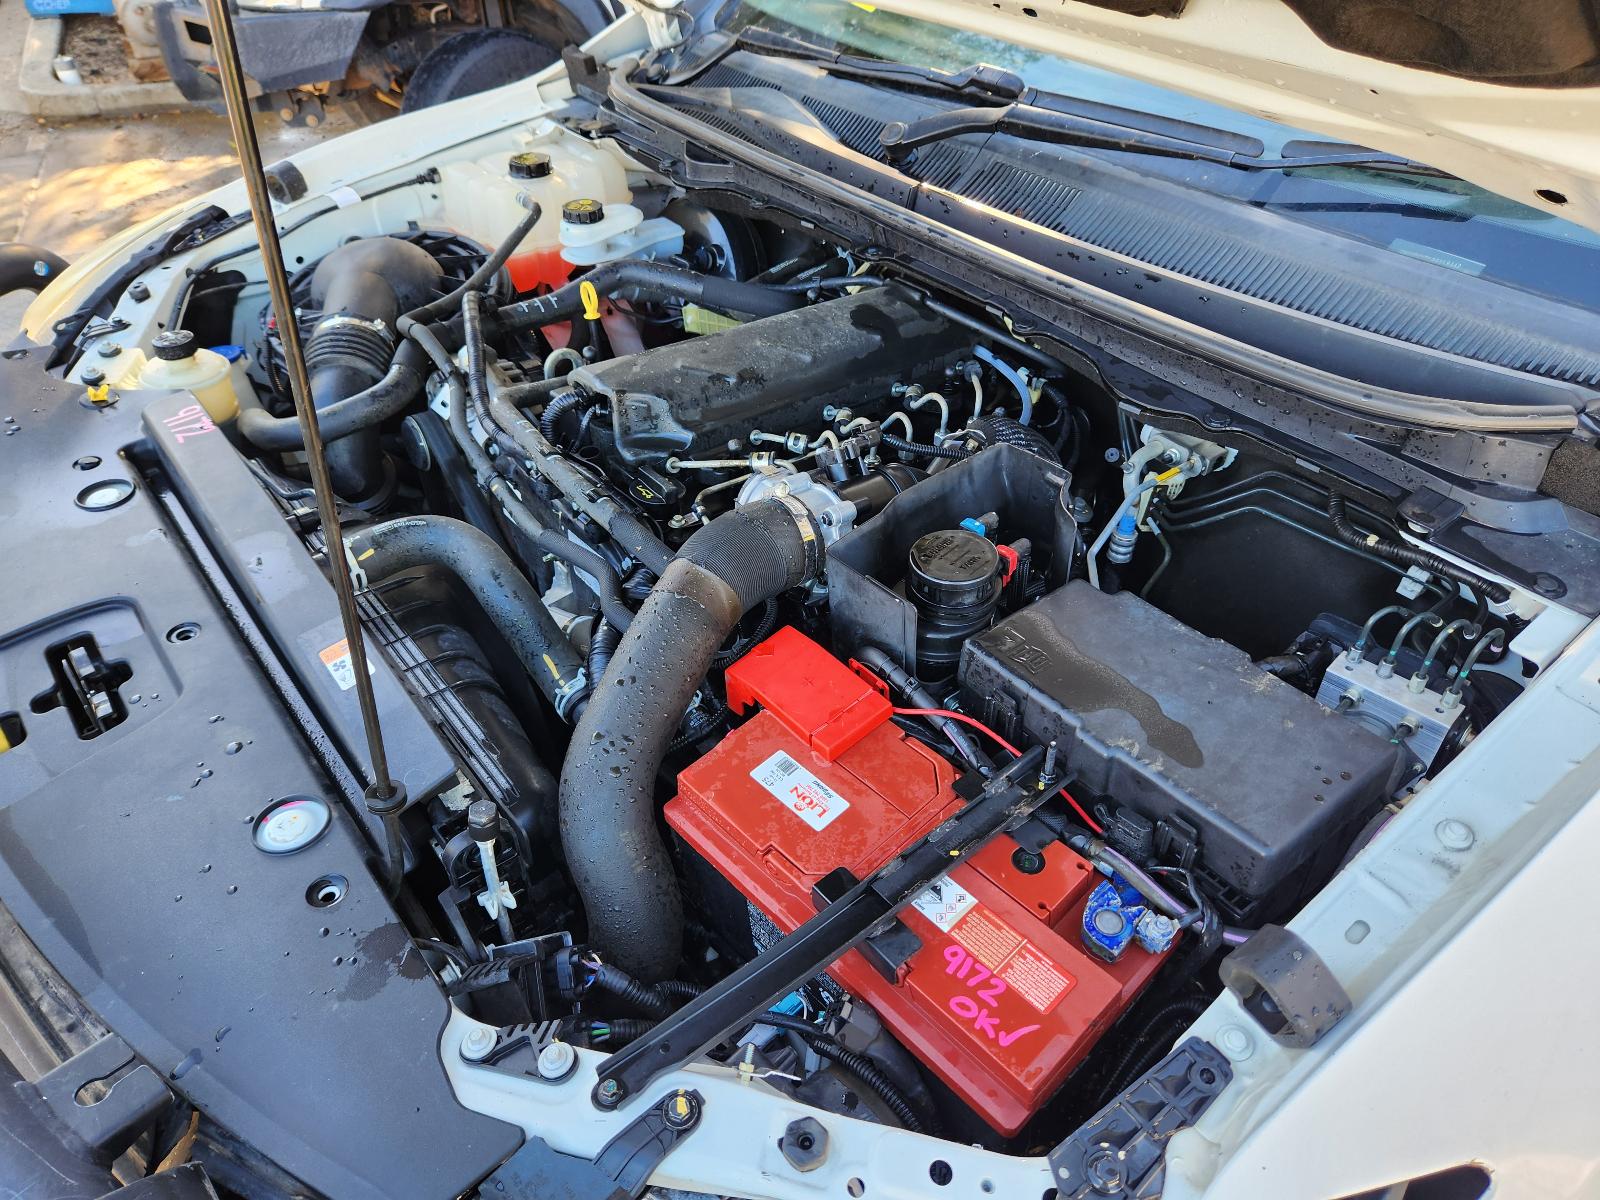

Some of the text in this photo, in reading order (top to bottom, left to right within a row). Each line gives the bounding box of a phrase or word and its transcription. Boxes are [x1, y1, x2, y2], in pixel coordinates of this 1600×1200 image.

[162, 405, 216, 444] 9172
[789, 786, 830, 818] LION
[943, 945, 1007, 1008] 9172
[950, 995, 1001, 1039] OK
